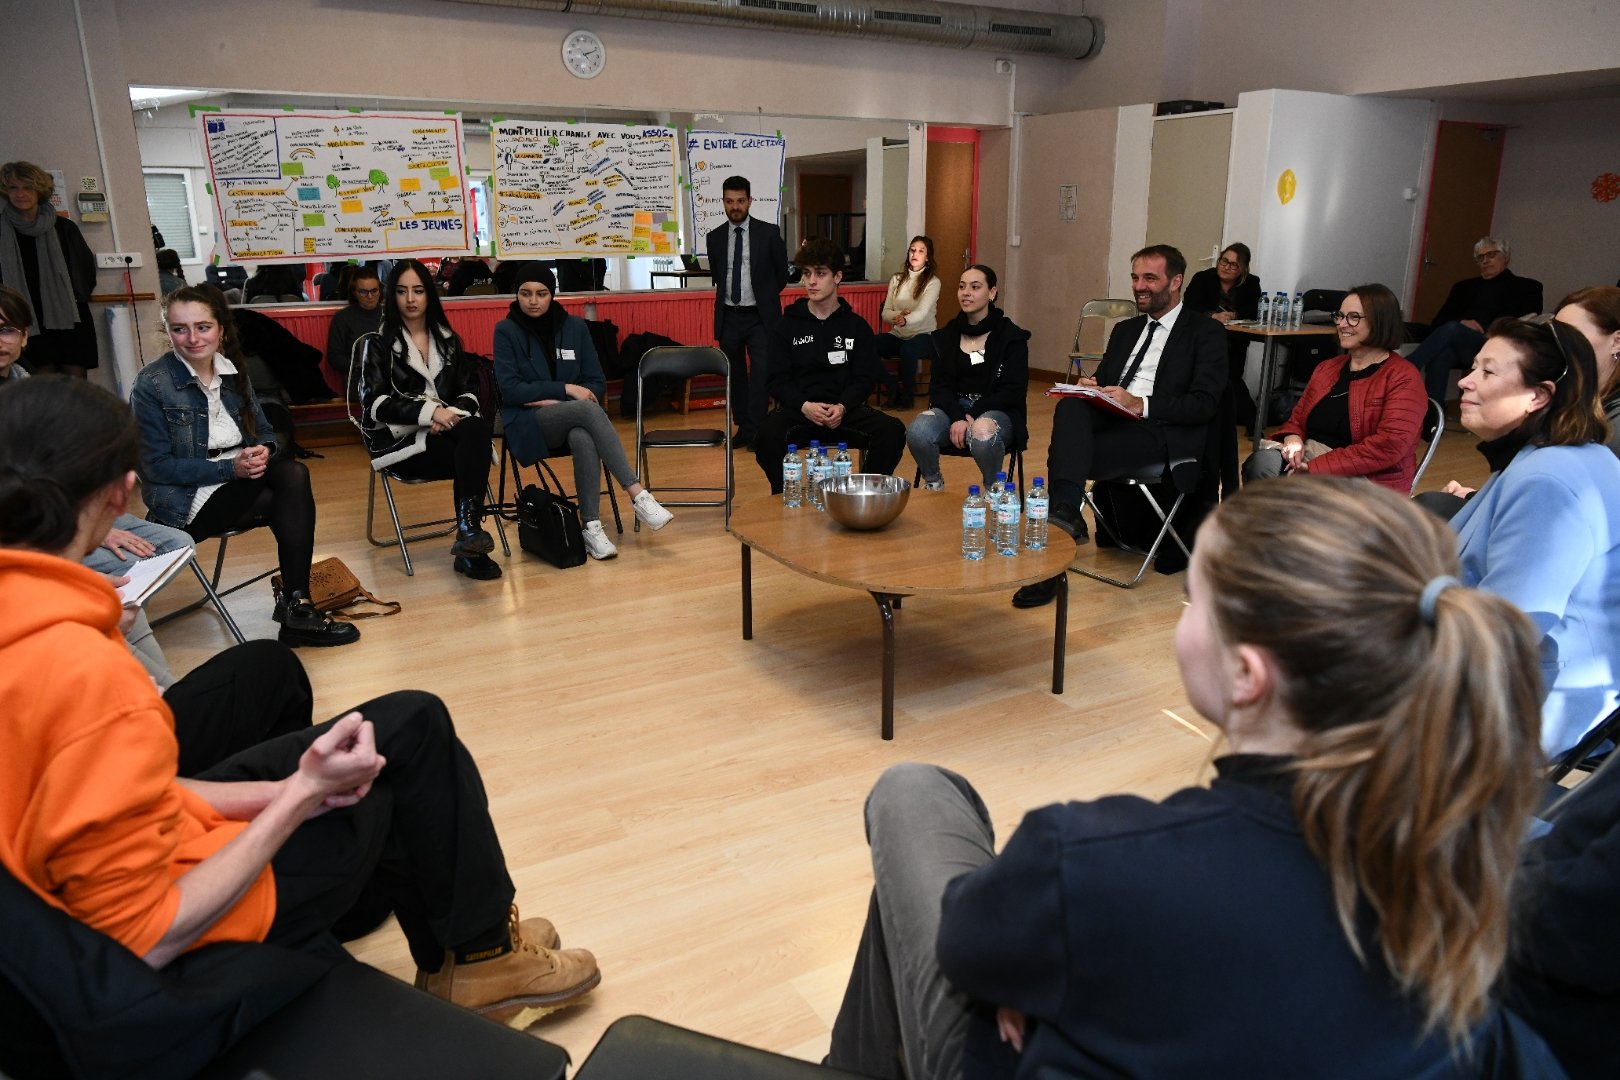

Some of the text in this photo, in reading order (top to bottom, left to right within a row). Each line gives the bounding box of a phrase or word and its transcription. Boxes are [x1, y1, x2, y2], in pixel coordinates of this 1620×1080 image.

[597, 131, 616, 139] AVEC
[399, 218, 463, 230] LES JEUNES
